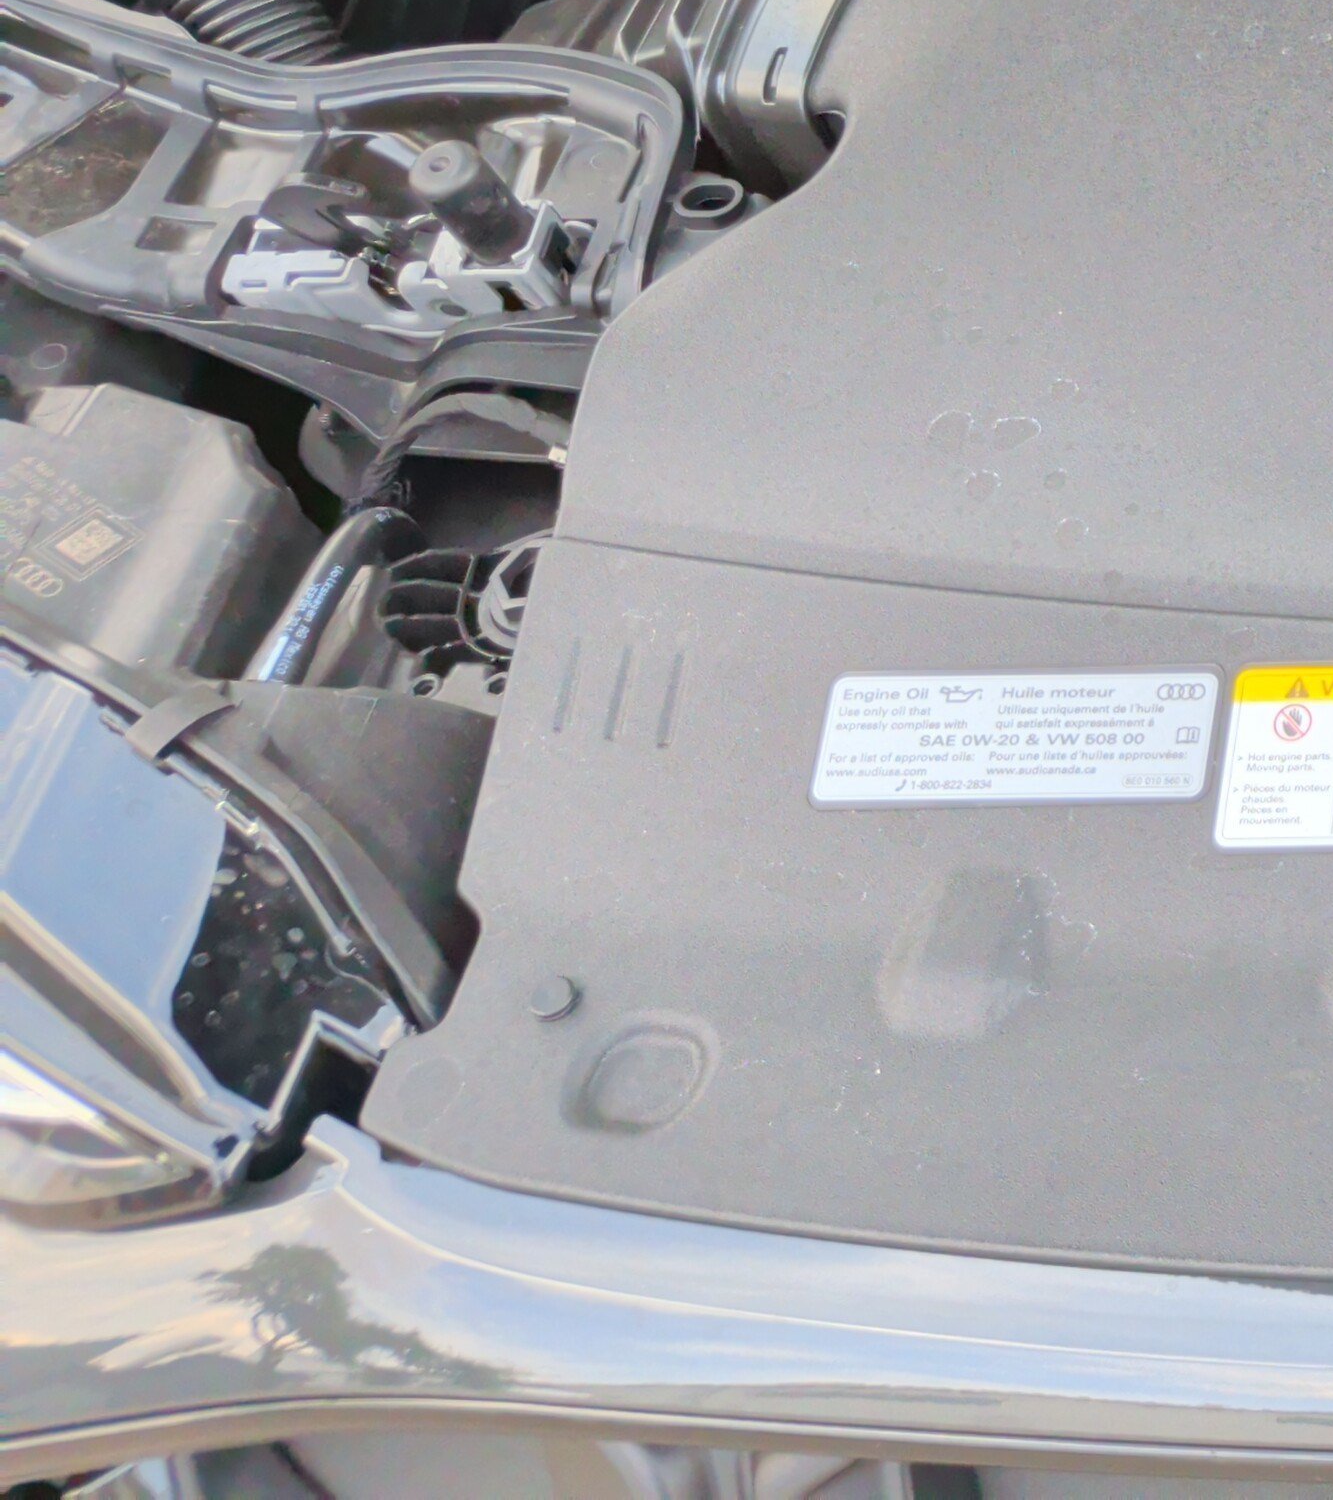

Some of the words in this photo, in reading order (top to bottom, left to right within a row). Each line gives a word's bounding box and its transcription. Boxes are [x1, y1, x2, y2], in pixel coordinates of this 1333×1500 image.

[843, 688, 900, 703] Engine
[907, 688, 929, 700] Oil
[1002, 687, 1044, 699] Huile
[1050, 687, 1115, 698] moteur
[839, 706, 859, 717] Use
[864, 706, 888, 718] only
[891, 706, 906, 716] oil
[909, 706, 931, 716] that
[998, 705, 1038, 715] Utilisez
[1042, 705, 1109, 716] uniquement
[1113, 704, 1126, 713] de
[836, 721, 888, 732] expressly
[890, 721, 941, 731] complies
[945, 720, 967, 729] with
[995, 719, 1014, 731] qui
[1016, 719, 1061, 729] satisfait
[920, 734, 956, 747] SAE
[962, 734, 1019, 746] 0W-20
[1025, 734, 1040, 745] &
[1047, 734, 1080, 745] VW
[1084, 734, 1117, 745] 508
[1122, 733, 1145, 745] 00
[829, 753, 847, 763] For
[860, 753, 877, 763] list
[880, 753, 893, 762] of
[895, 752, 949, 766] approved
[952, 751, 975, 762] oils:
[989, 751, 1015, 761] Pour
[1019, 752, 1040, 761] une
[1043, 751, 1068, 761] liste
[1248, 753, 1265, 762] Hot
[1268, 753, 1302, 764] engine
[826, 767, 927, 777] www.audiusa.com
[986, 765, 1097, 775] www.audicanada.ca
[1246, 763, 1284, 773] Moving
[911, 779, 992, 790] 1-800-822-2834
[1278, 784, 1291, 792] du
[1294, 784, 1330, 792] moteur
